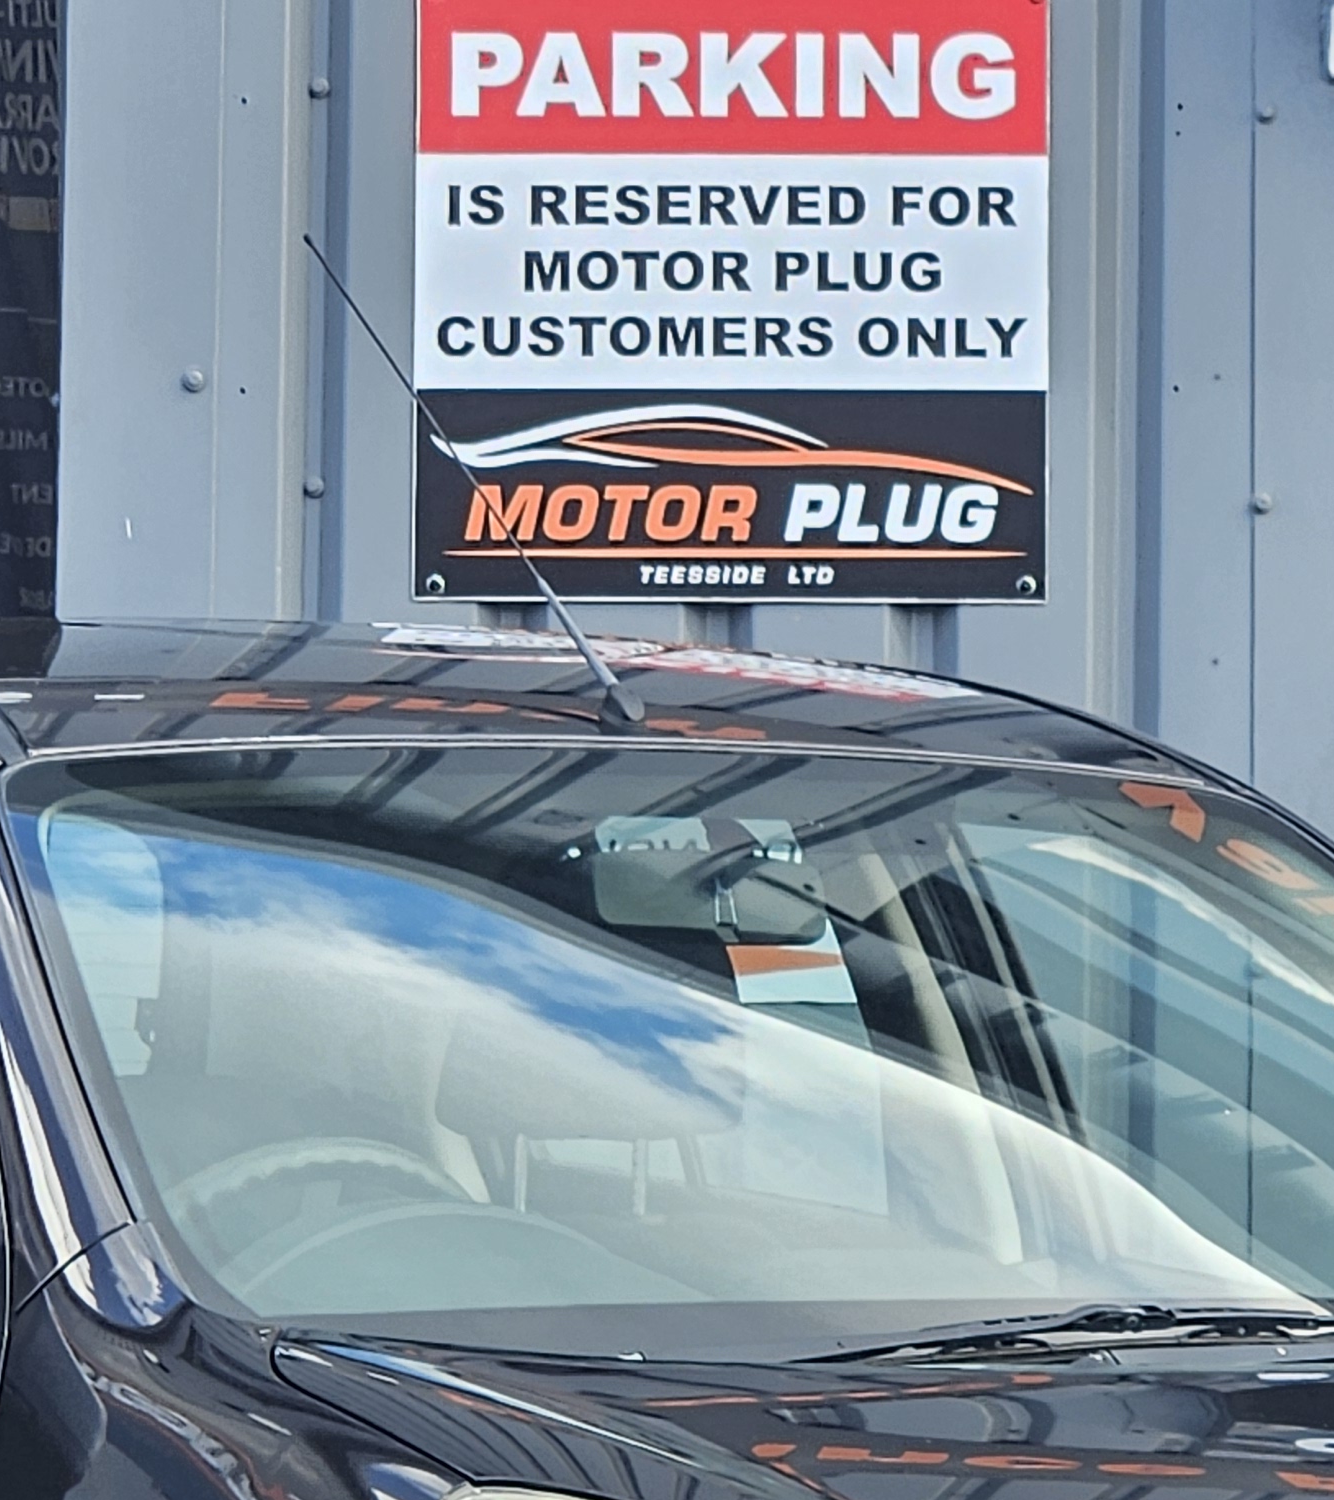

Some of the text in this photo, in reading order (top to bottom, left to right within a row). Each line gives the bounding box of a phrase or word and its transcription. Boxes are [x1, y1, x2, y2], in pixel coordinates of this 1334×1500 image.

[450, 32, 1016, 118] PARKING
[447, 186, 1017, 227] IS RESERVED FOR
[523, 251, 943, 292] MOTOR PLUG
[437, 316, 1026, 358] CUSTOMERS ONLY
[465, 482, 999, 543] MOTOR PLUG
[639, 564, 834, 585] TEESSIDE LTD
